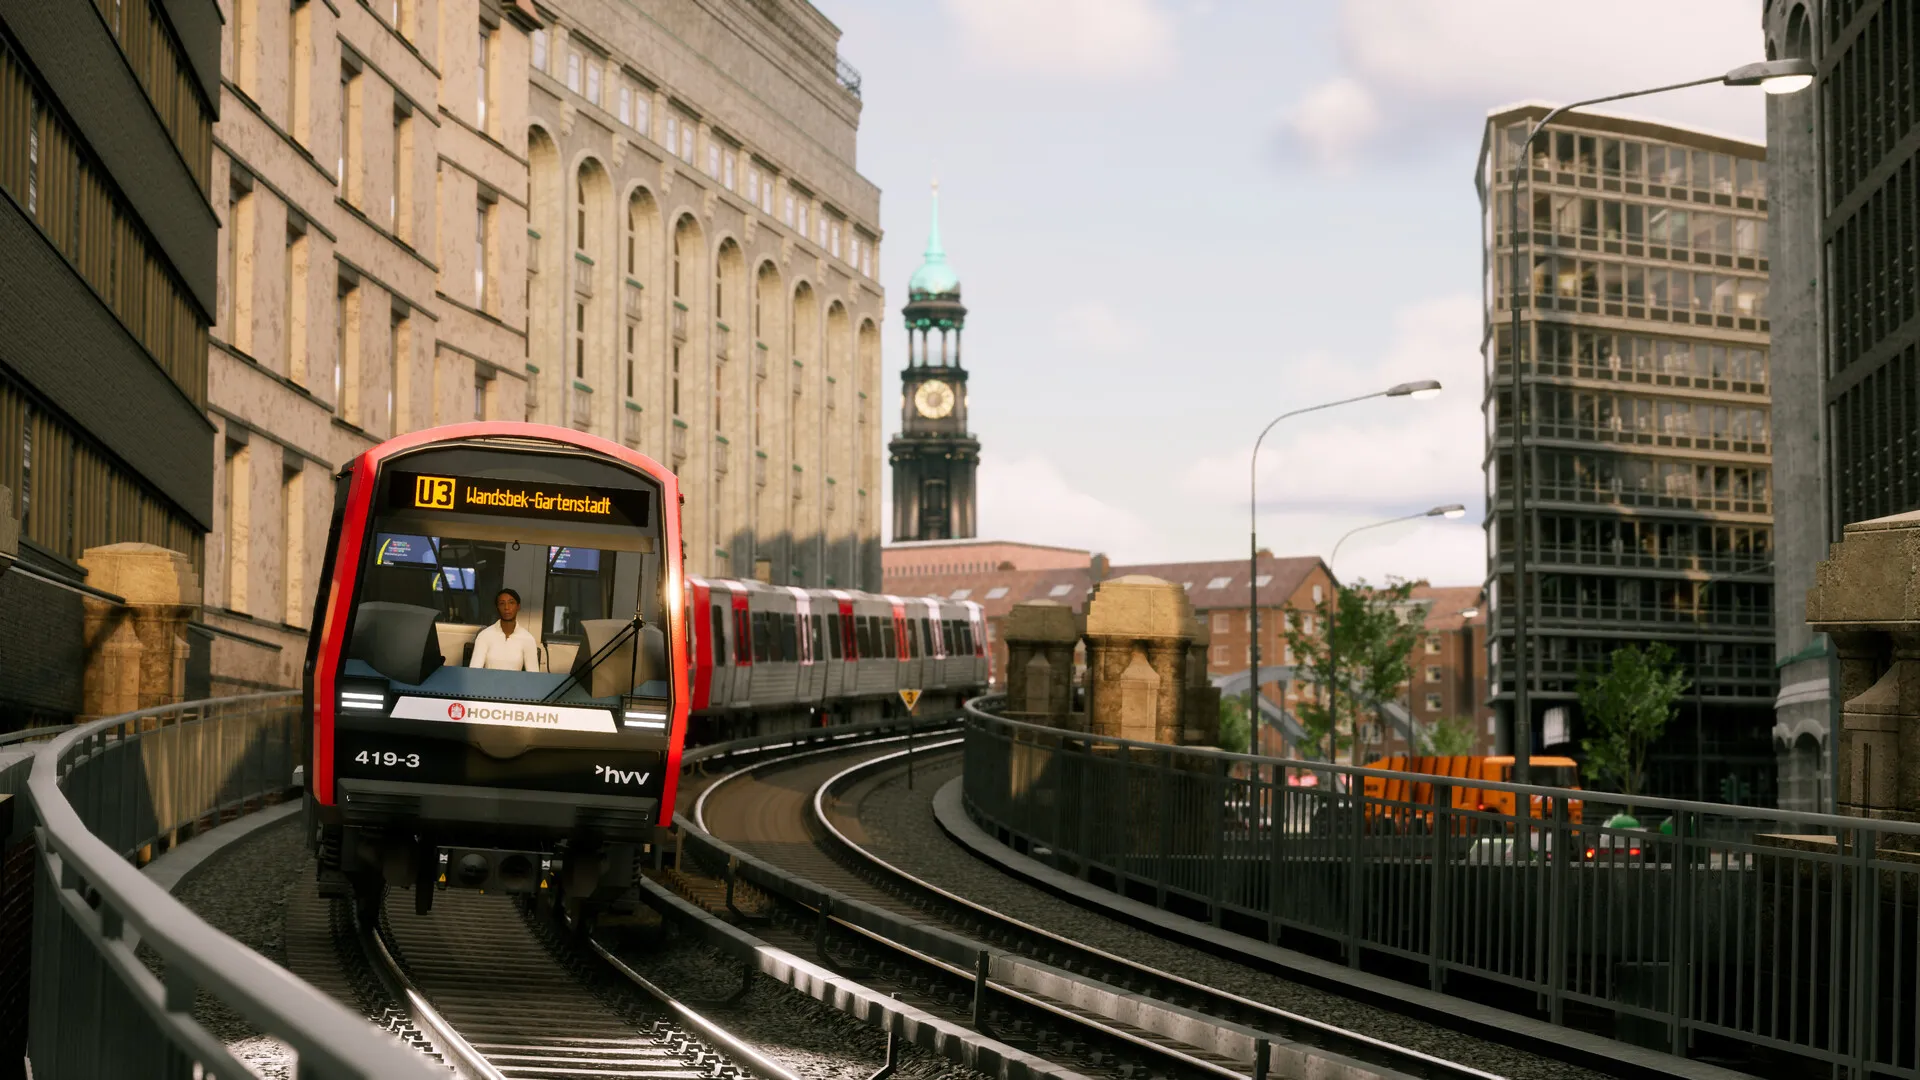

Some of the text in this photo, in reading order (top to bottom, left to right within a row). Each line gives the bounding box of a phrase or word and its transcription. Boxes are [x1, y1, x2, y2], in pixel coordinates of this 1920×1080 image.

[419, 479, 611, 515] U3 Wandsbek-Gartenstadt
[906, 691, 914, 704] 3
[467, 706, 559, 724] HOCHBAHN
[354, 750, 420, 768] 419-3
